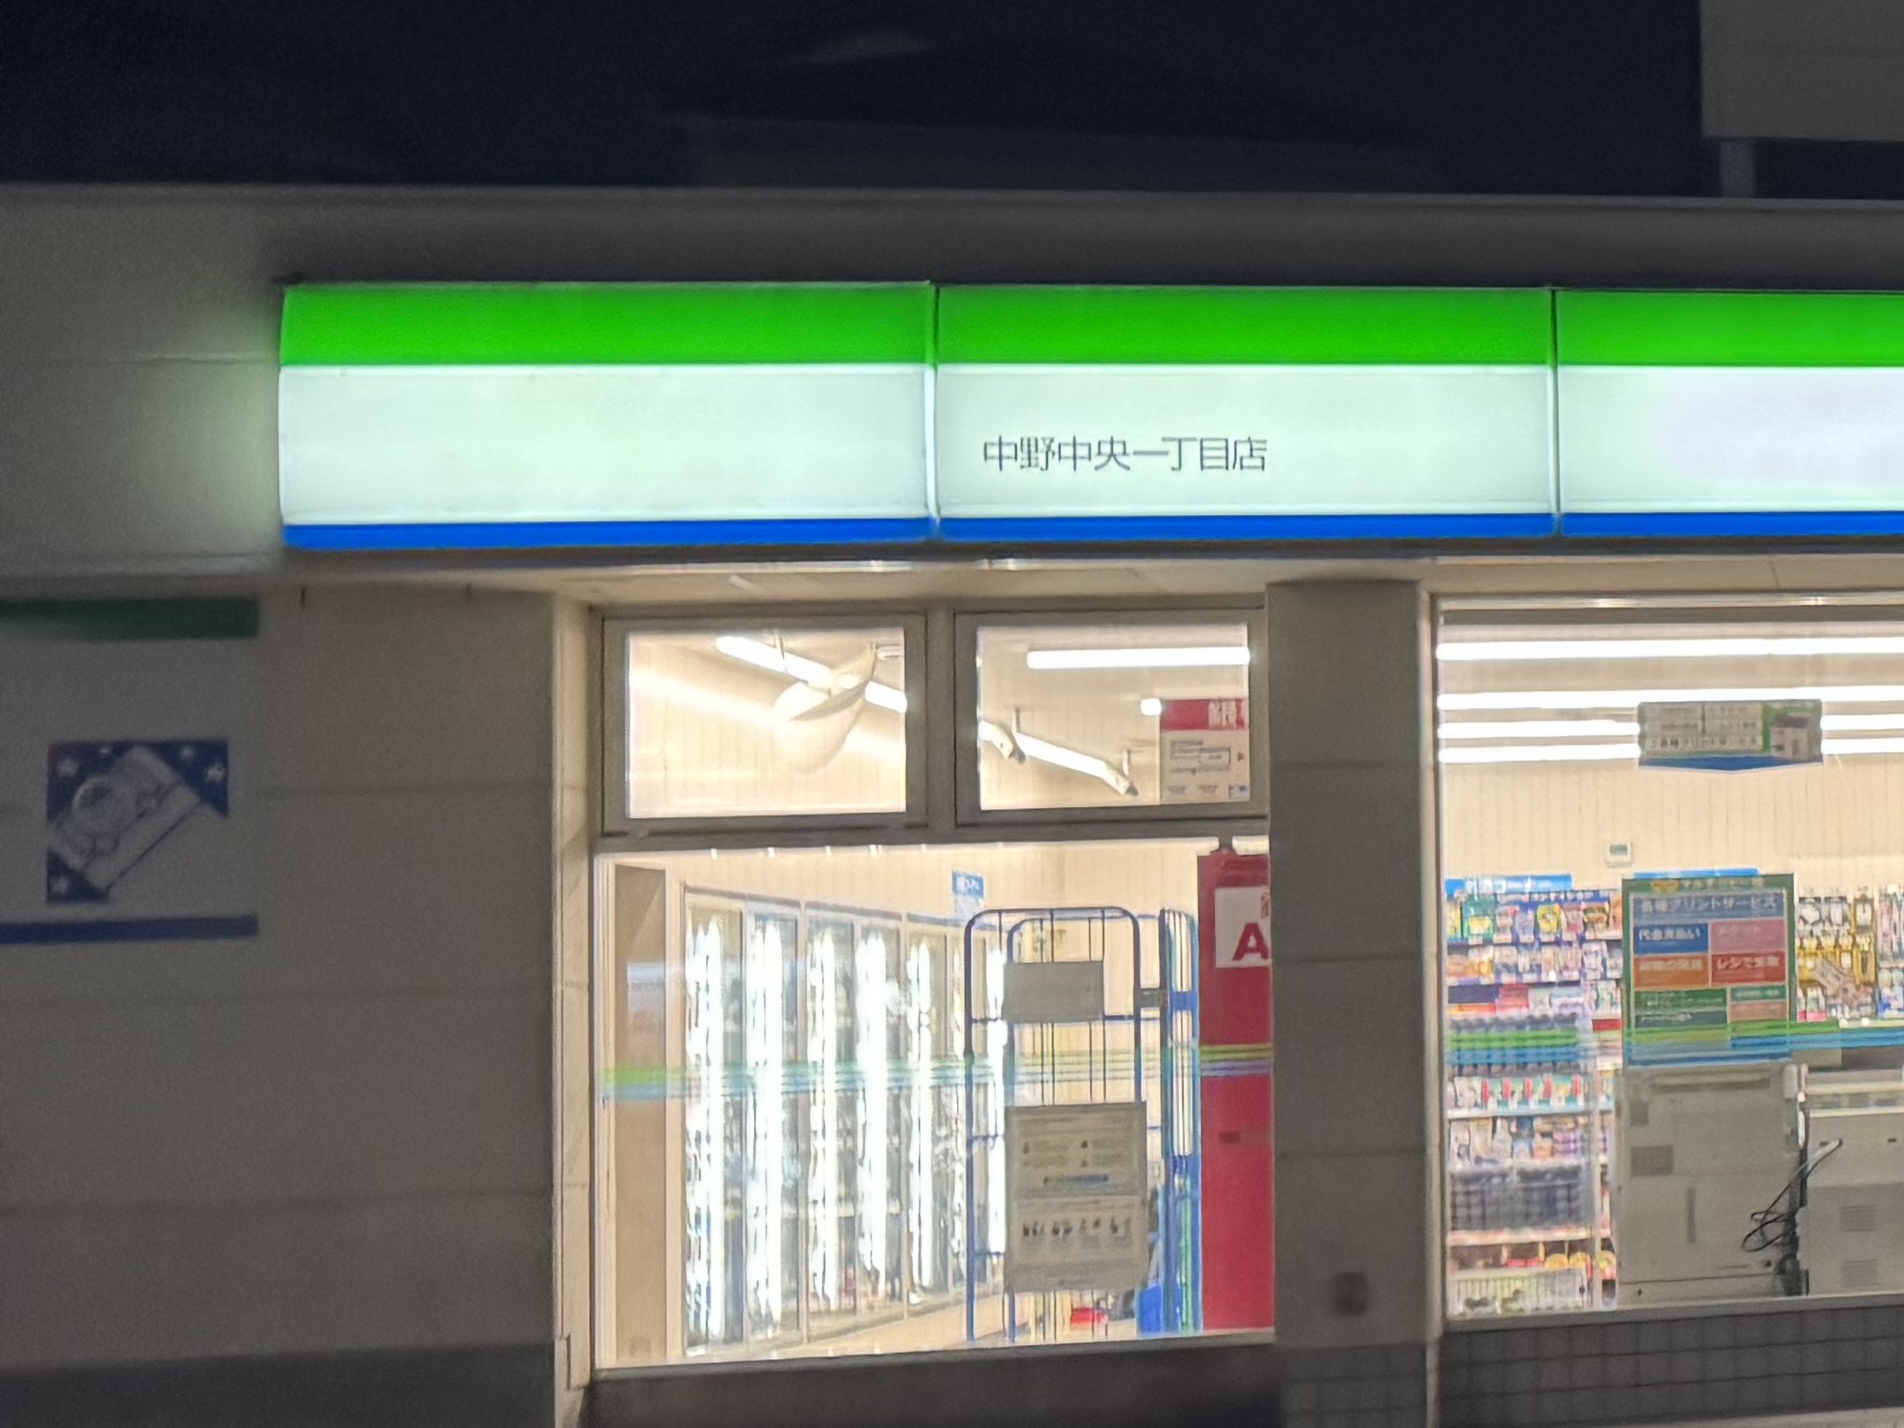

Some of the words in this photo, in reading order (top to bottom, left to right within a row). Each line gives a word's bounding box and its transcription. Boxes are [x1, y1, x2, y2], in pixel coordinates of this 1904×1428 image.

[983, 435, 1267, 471] 中野中央一丁目店
[1232, 923, 1269, 961] A
